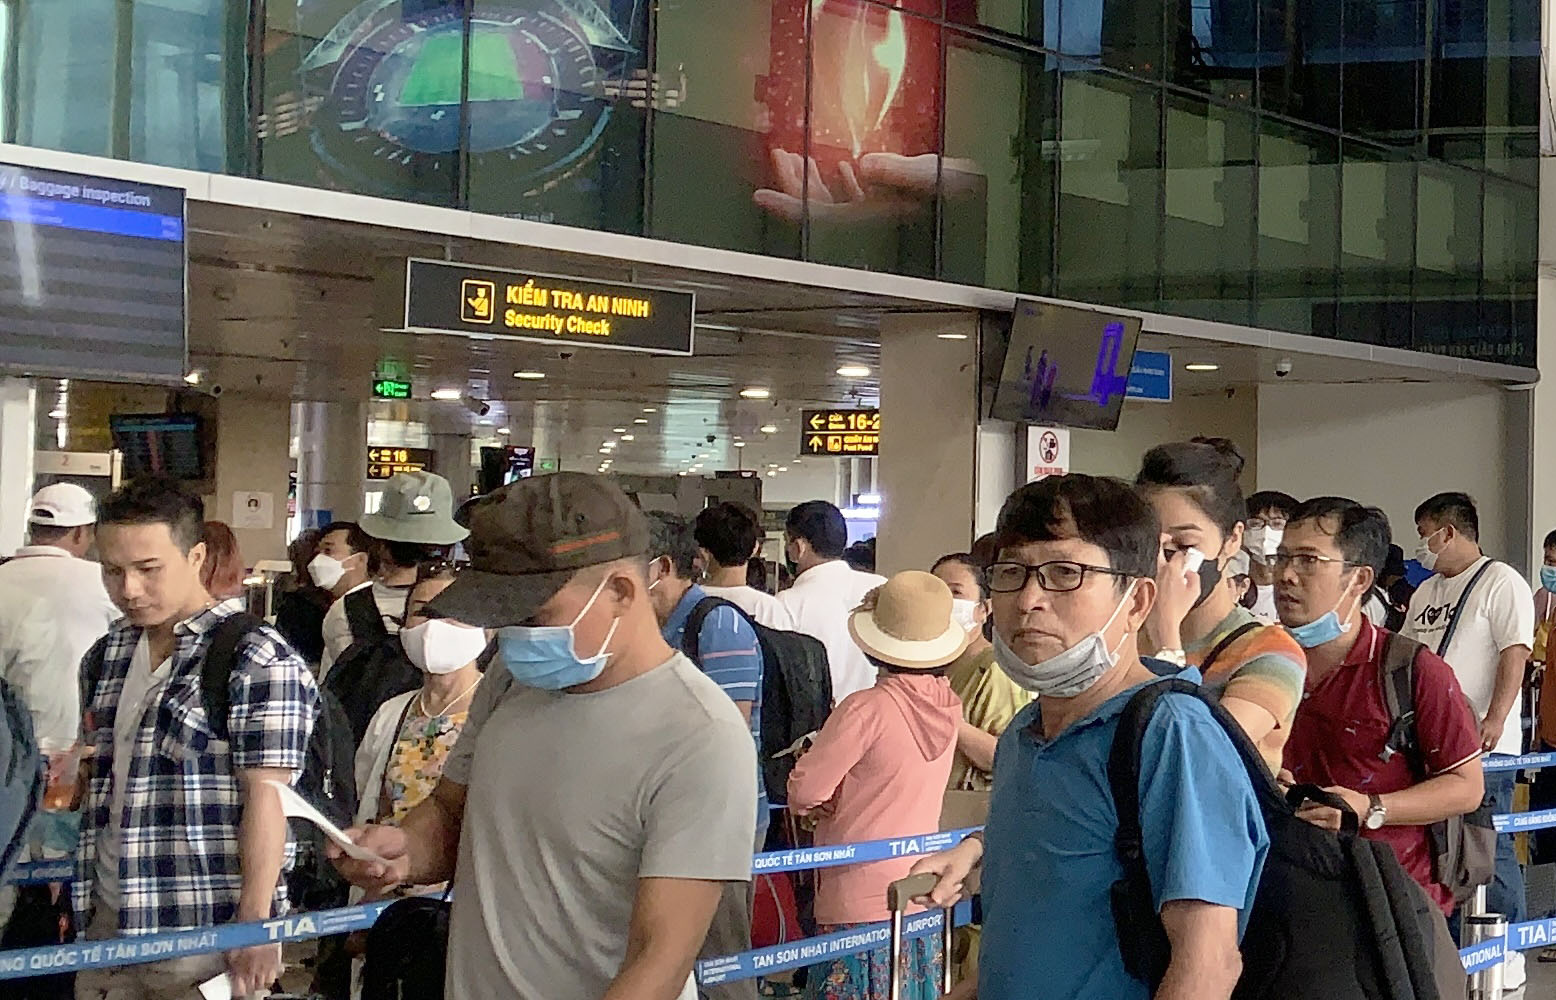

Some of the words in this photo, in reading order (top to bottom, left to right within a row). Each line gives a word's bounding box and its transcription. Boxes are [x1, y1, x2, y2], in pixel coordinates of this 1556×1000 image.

[20, 175, 79, 199] Baggage
[506, 279, 548, 307] KIỂM
[551, 290, 584, 311] TRA
[586, 295, 609, 313] AN
[611, 297, 649, 318] NINH
[504, 309, 564, 335] Security
[566, 315, 610, 336] Check
[754, 850, 781, 869] QUỐC
[782, 850, 793, 866] TẾ
[795, 850, 812, 865] TÂN
[813, 849, 833, 863] SƠN
[833, 845, 856, 861] NHẤT
[889, 839, 920, 856] TIA
[30, 948, 77, 969] QUỐC
[105, 941, 136, 960] TÂN
[140, 938, 173, 956] SƠN
[177, 931, 218, 952] NHẤT
[263, 917, 318, 940] TIA
[1518, 924, 1547, 946] TIA
[752, 953, 774, 969] TAN
[776, 949, 798, 965] SON
[800, 942, 828, 960] NHAT
[1460, 947, 1501, 969] NATIONAL
